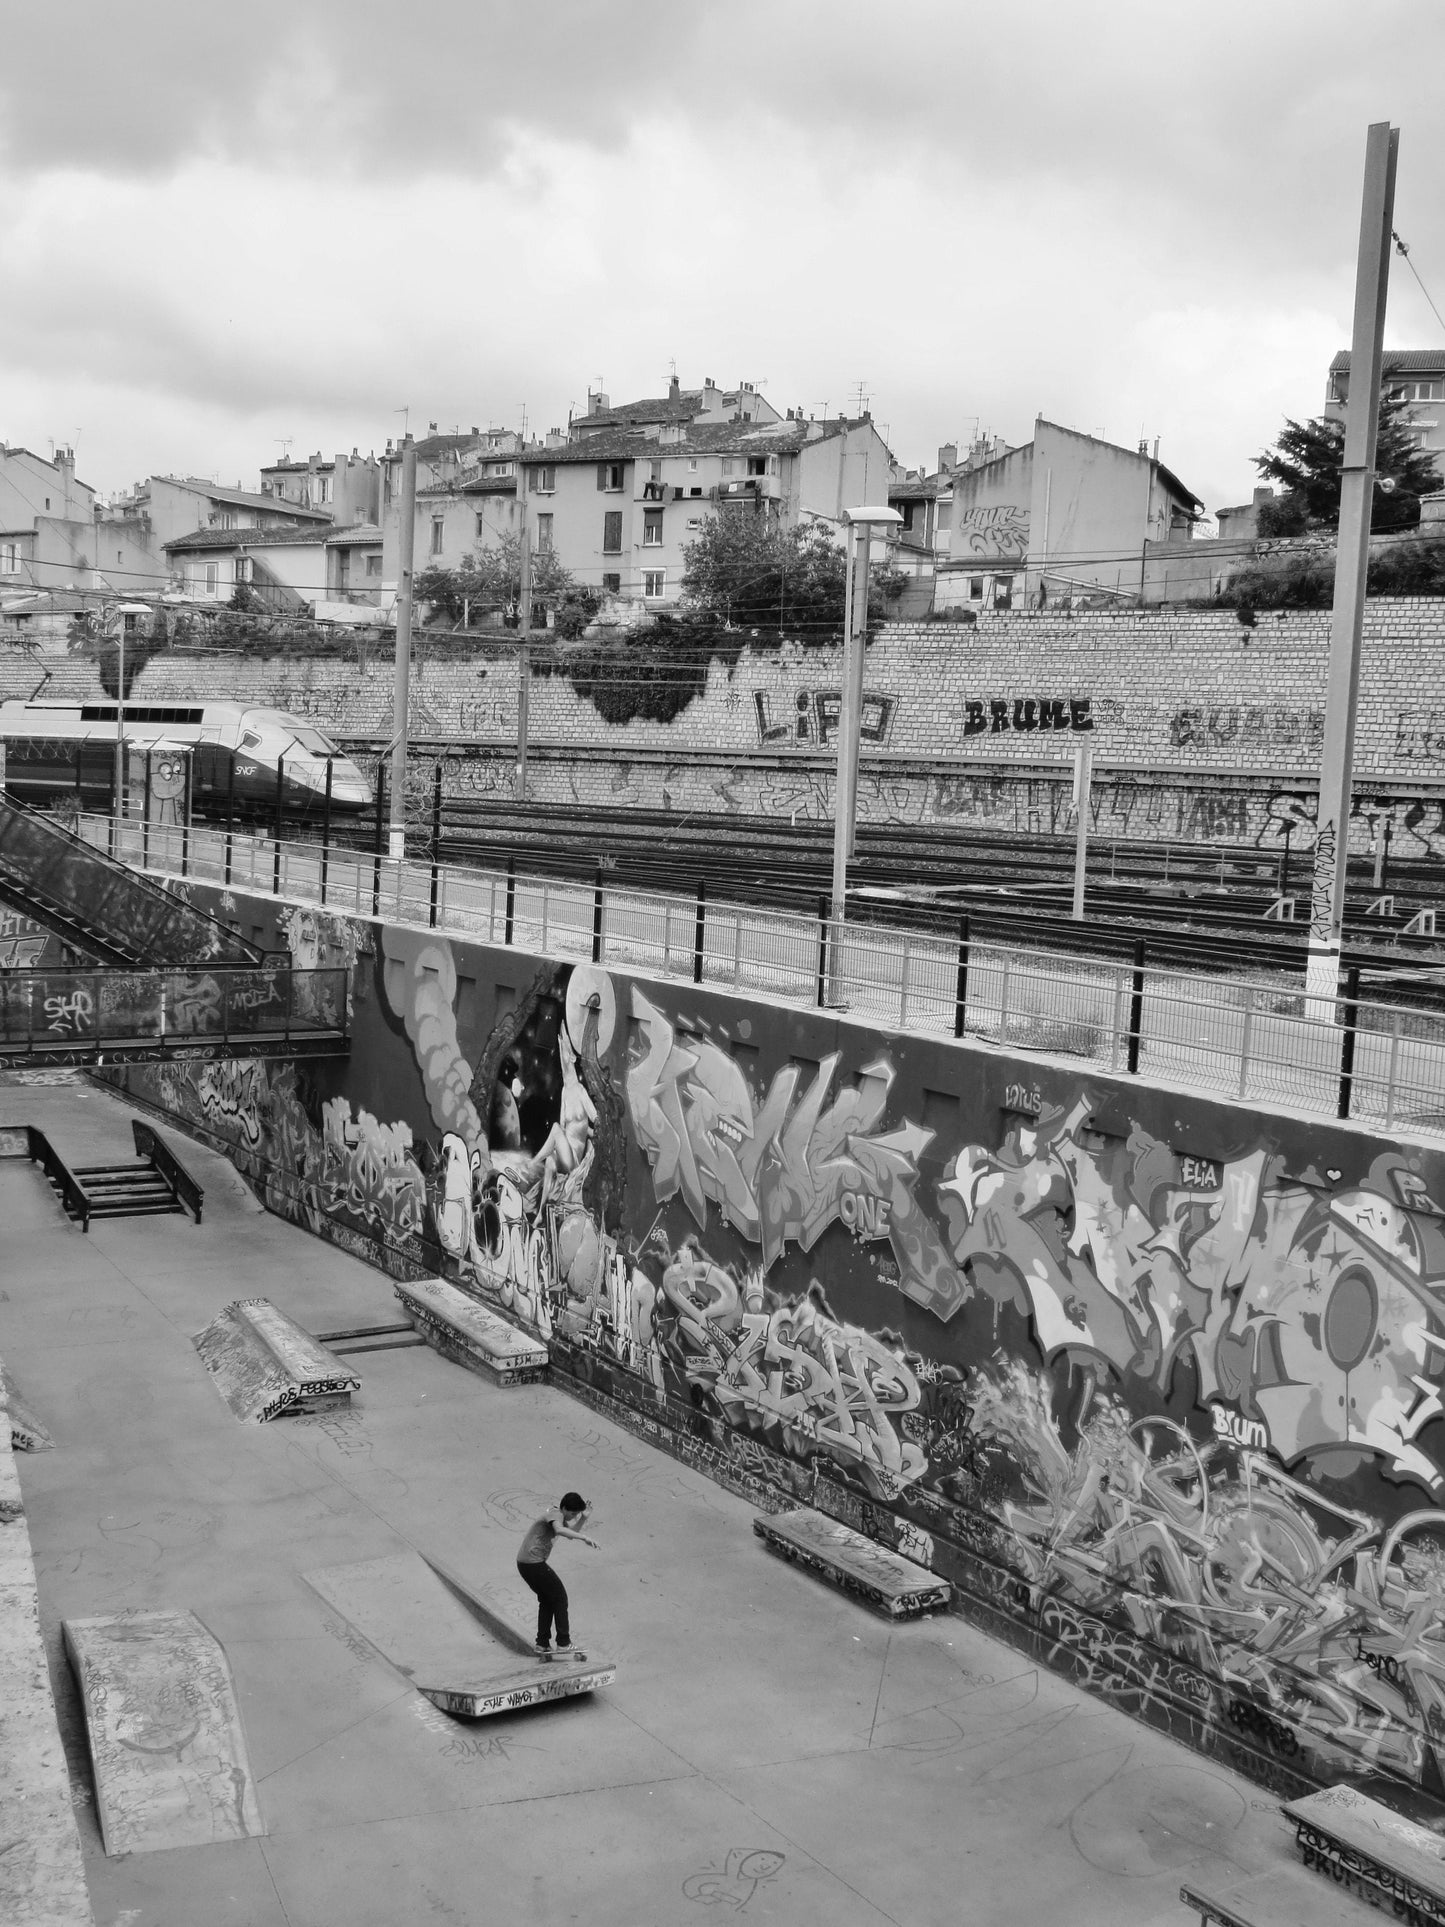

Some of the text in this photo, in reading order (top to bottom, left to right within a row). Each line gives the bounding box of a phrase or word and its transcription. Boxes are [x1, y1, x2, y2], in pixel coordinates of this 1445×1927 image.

[962, 697, 1095, 738] BRUME
[234, 766, 257, 776] SNCF
[840, 1192, 892, 1237] ONE
[1211, 1404, 1268, 1448] Brum
